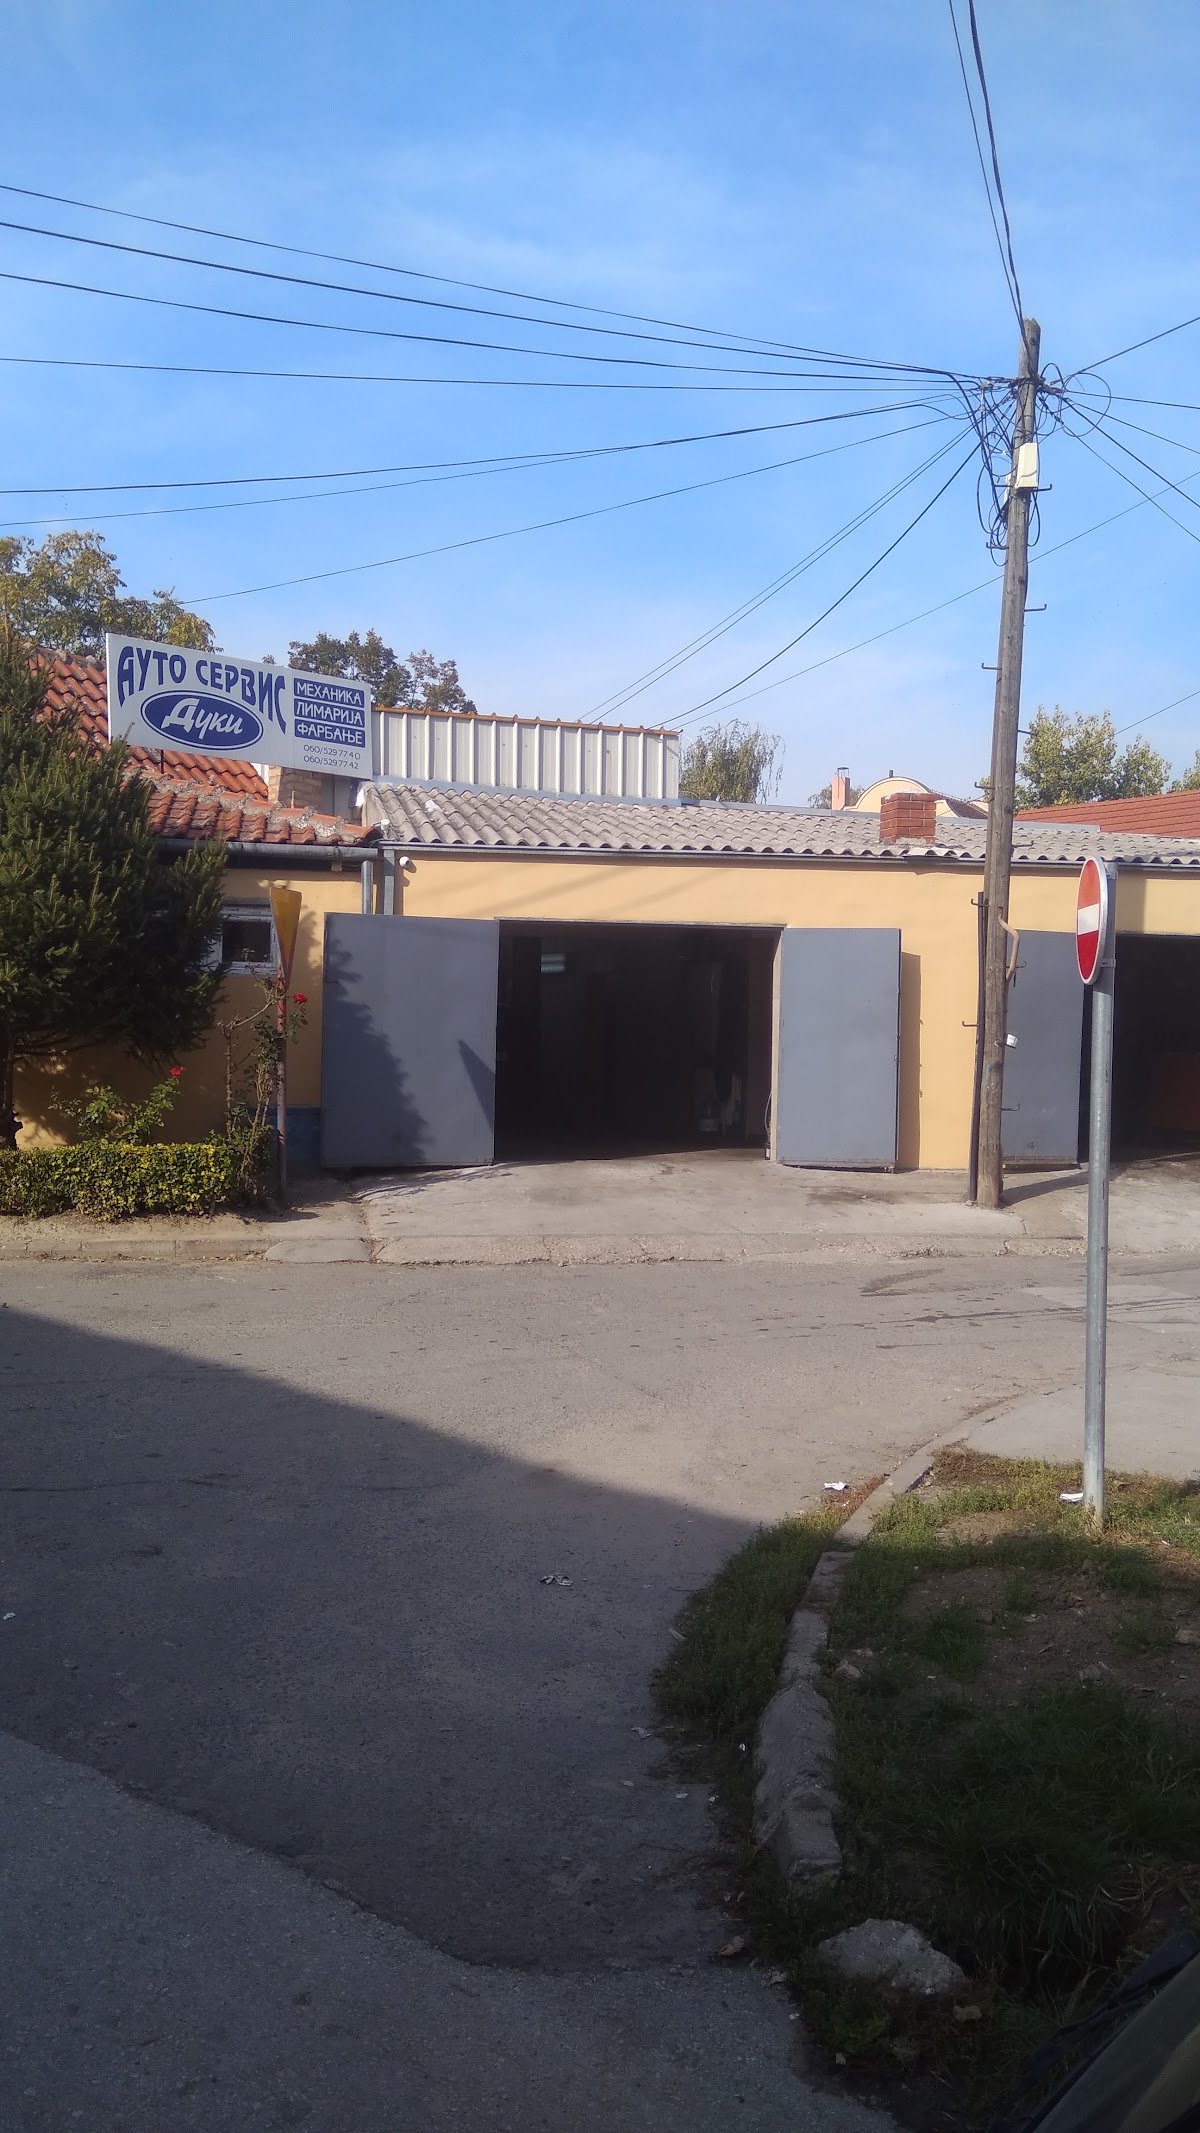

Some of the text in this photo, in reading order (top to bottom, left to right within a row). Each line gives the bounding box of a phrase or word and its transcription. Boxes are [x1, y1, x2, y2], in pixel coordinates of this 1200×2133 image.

[117, 645, 286, 735] АУТО СЕРВИС
[296, 681, 362, 706] МЕХАНИКА
[296, 701, 363, 726] ЛИМАРИЈА
[297, 722, 363, 744] ФАРБАЊЕ
